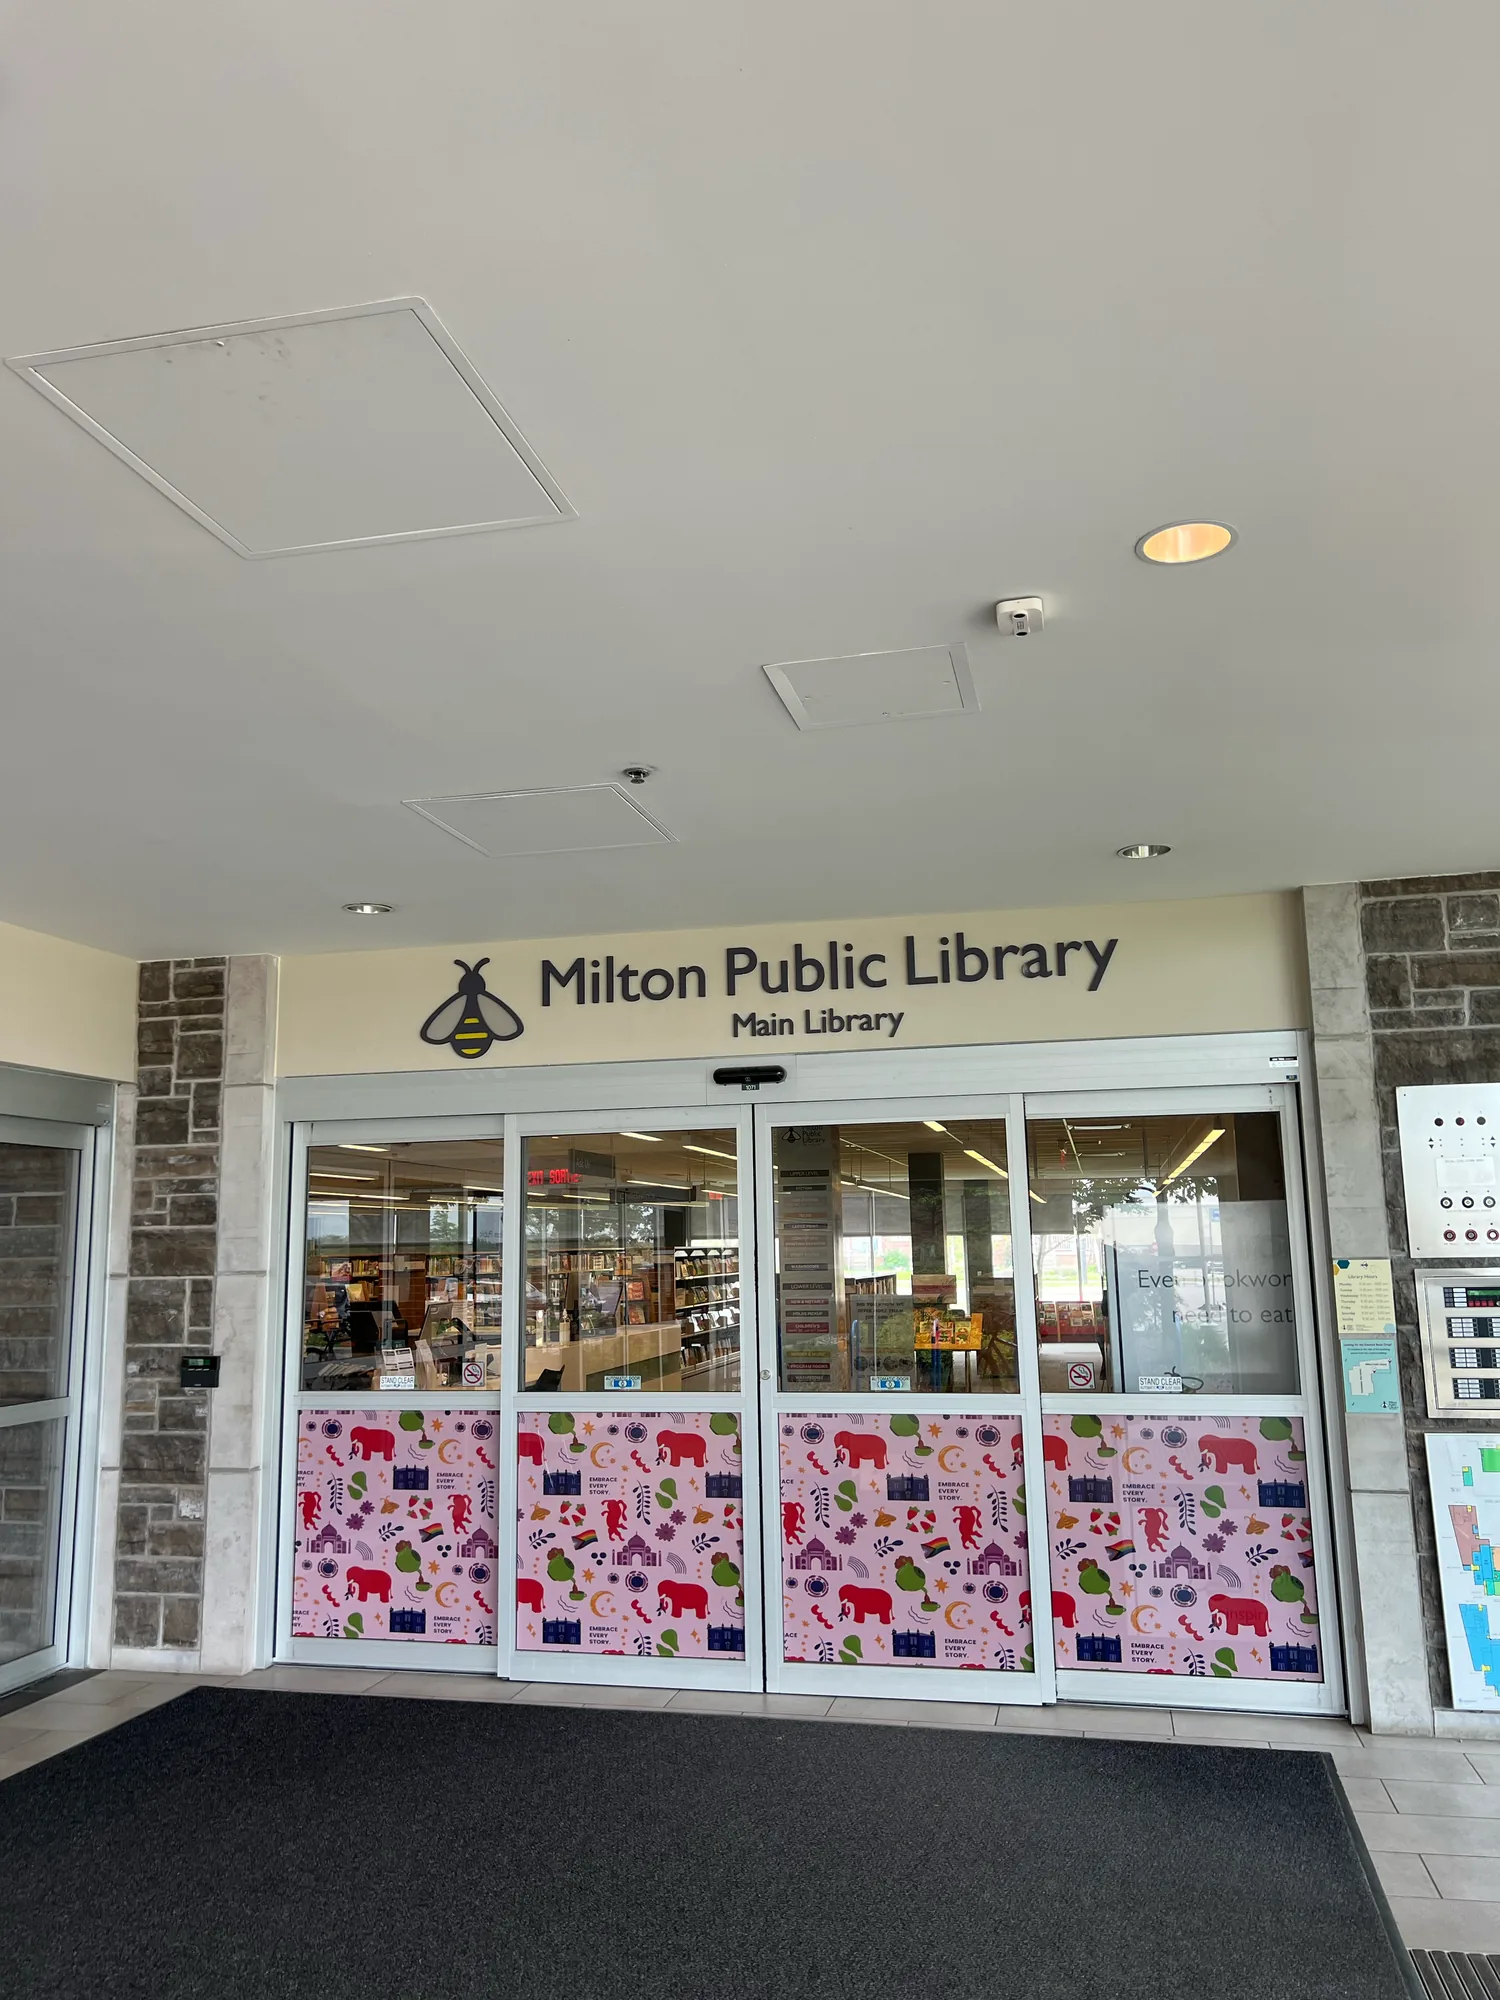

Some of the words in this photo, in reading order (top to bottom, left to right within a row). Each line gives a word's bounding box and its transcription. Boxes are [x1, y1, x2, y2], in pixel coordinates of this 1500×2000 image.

[542, 955, 706, 1007] Milton
[726, 941, 887, 996] Public
[906, 932, 1119, 992] Library
[733, 1012, 794, 1037] Main
[805, 1008, 905, 1038] Library
[527, 1170, 544, 1186] EXIT
[1230, 1306, 1253, 1324] to
[1260, 1307, 1294, 1324] eat
[1140, 1377, 1160, 1386] STAND
[1161, 1377, 1181, 1386] CLEAR
[1131, 1642, 1165, 1650] EMBRACE
